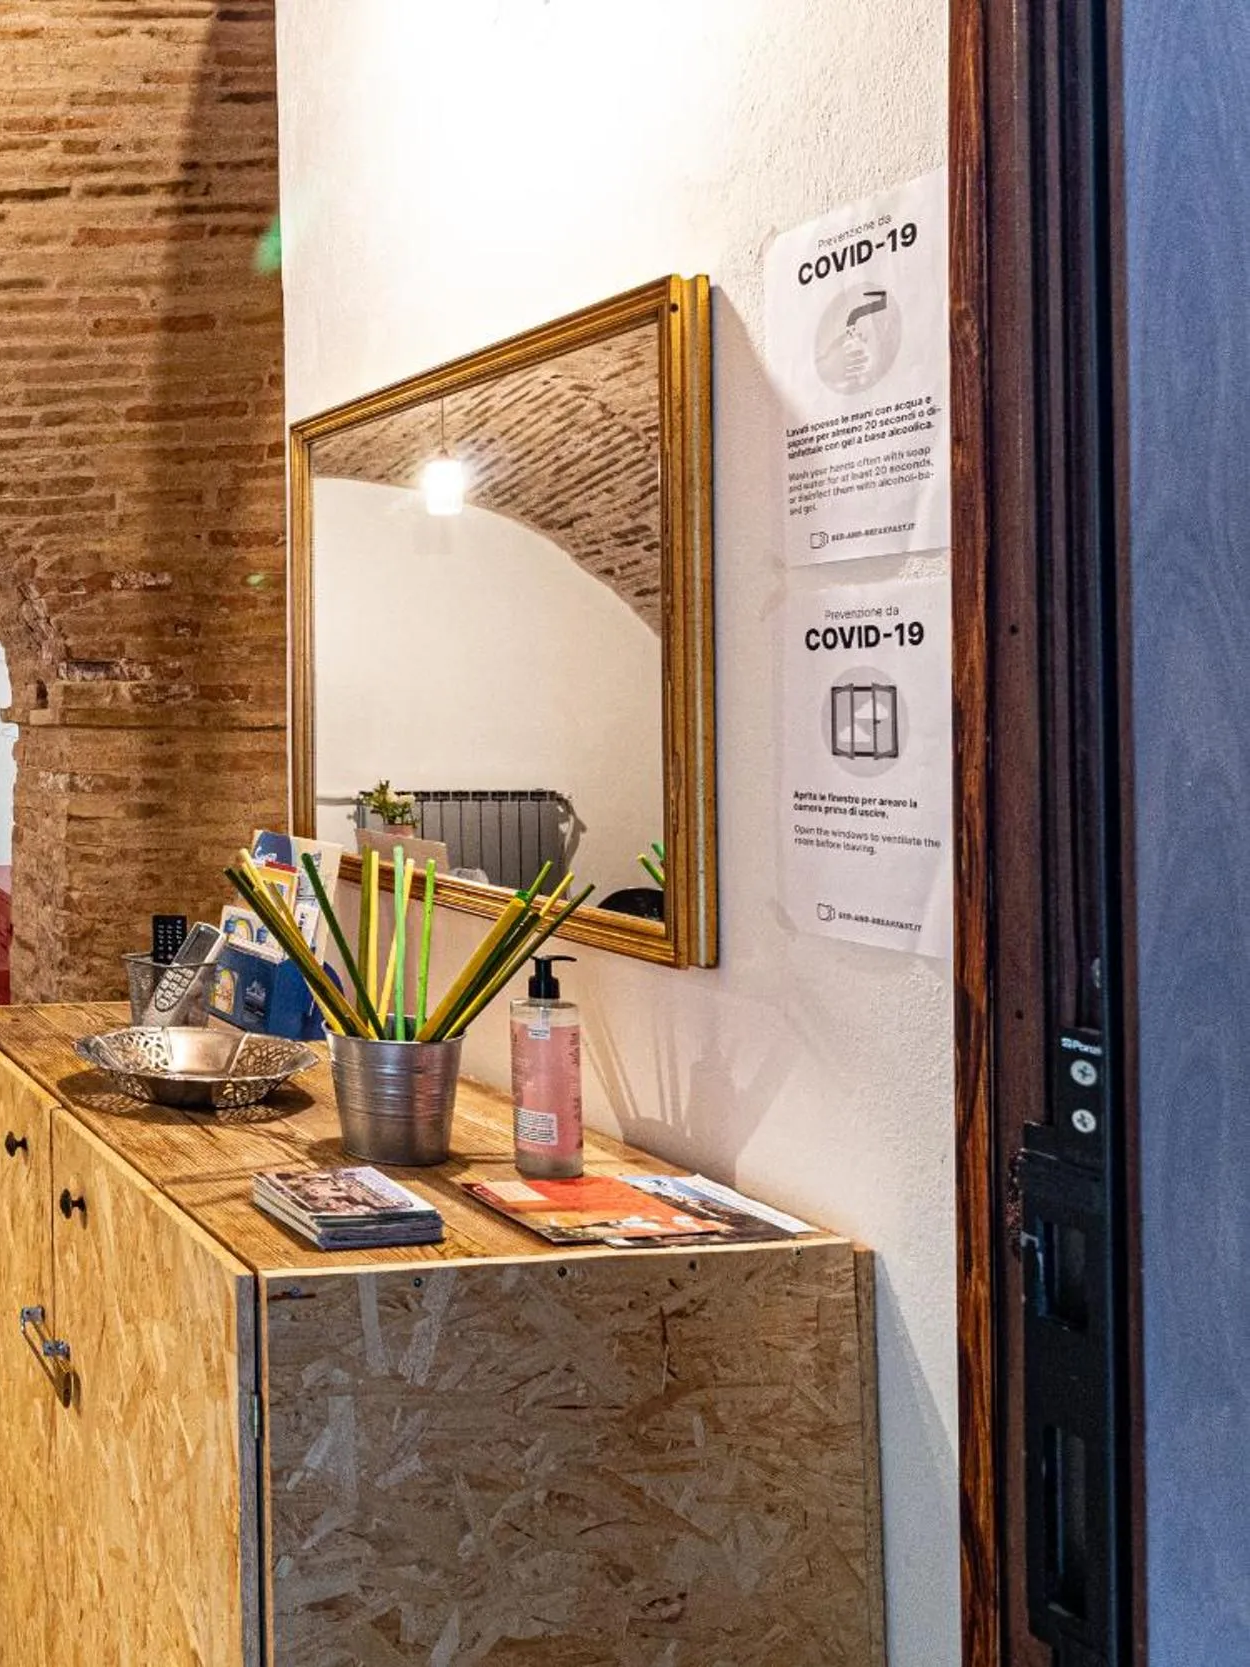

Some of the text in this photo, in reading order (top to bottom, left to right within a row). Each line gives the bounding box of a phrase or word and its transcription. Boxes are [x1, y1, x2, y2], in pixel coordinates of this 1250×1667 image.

[798, 222, 918, 285] COVID-19
[875, 406, 892, 416] con
[895, 398, 923, 411] acqua
[865, 420, 877, 430] 20
[864, 431, 886, 442] base
[906, 446, 931, 458] soap
[874, 465, 888, 476] 20
[824, 605, 900, 619] Prevenzione da
[805, 621, 924, 651] COVID-19
[861, 797, 878, 807] per
[909, 797, 918, 809] la
[849, 806, 857, 816] di
[924, 837, 941, 848] the
